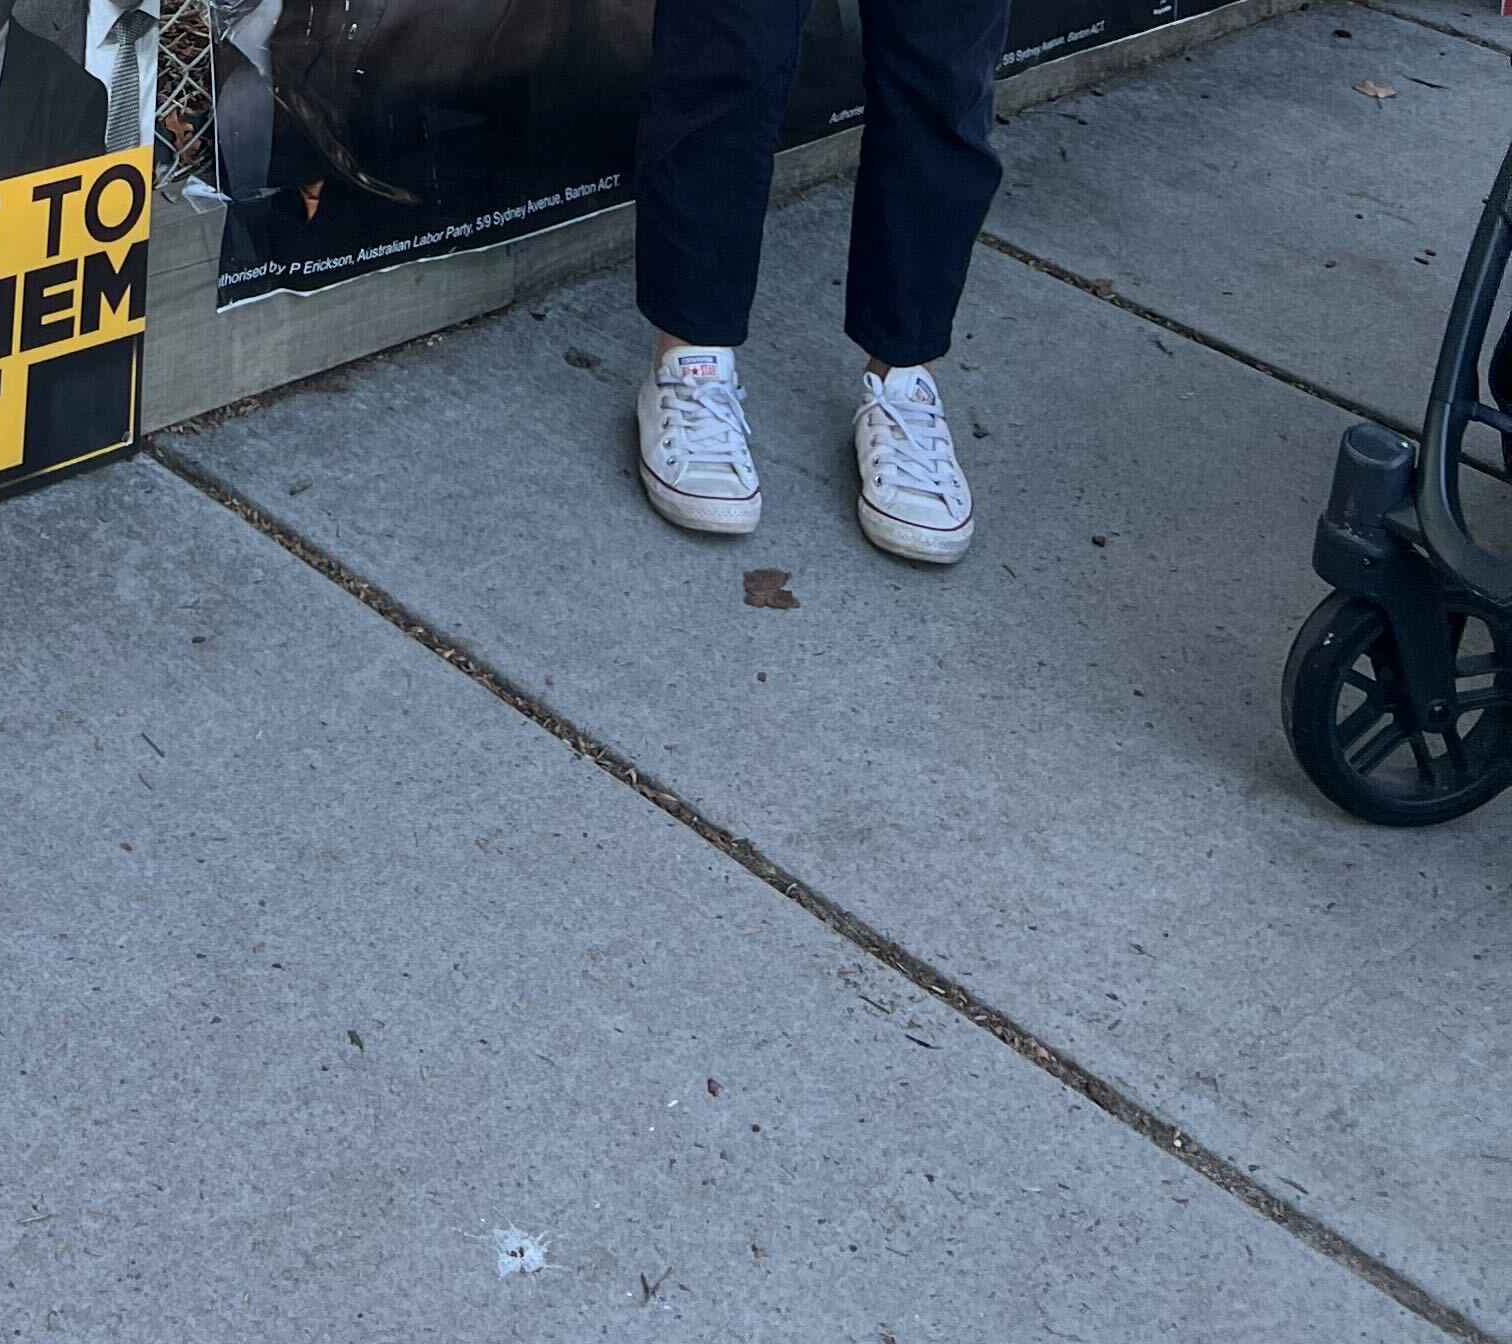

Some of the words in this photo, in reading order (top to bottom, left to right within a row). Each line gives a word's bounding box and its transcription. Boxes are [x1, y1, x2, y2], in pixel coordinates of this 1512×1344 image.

[32, 163, 146, 258] TO
[268, 259, 287, 276] by
[289, 262, 302, 275] P
[303, 253, 355, 275] Erickson,
[356, 238, 411, 263] Australian
[412, 229, 444, 249] Labor
[475, 214, 492, 232] 5/9
[492, 204, 527, 227] Sydney
[527, 191, 565, 214] Avenue,
[565, 183, 597, 203] Barton
